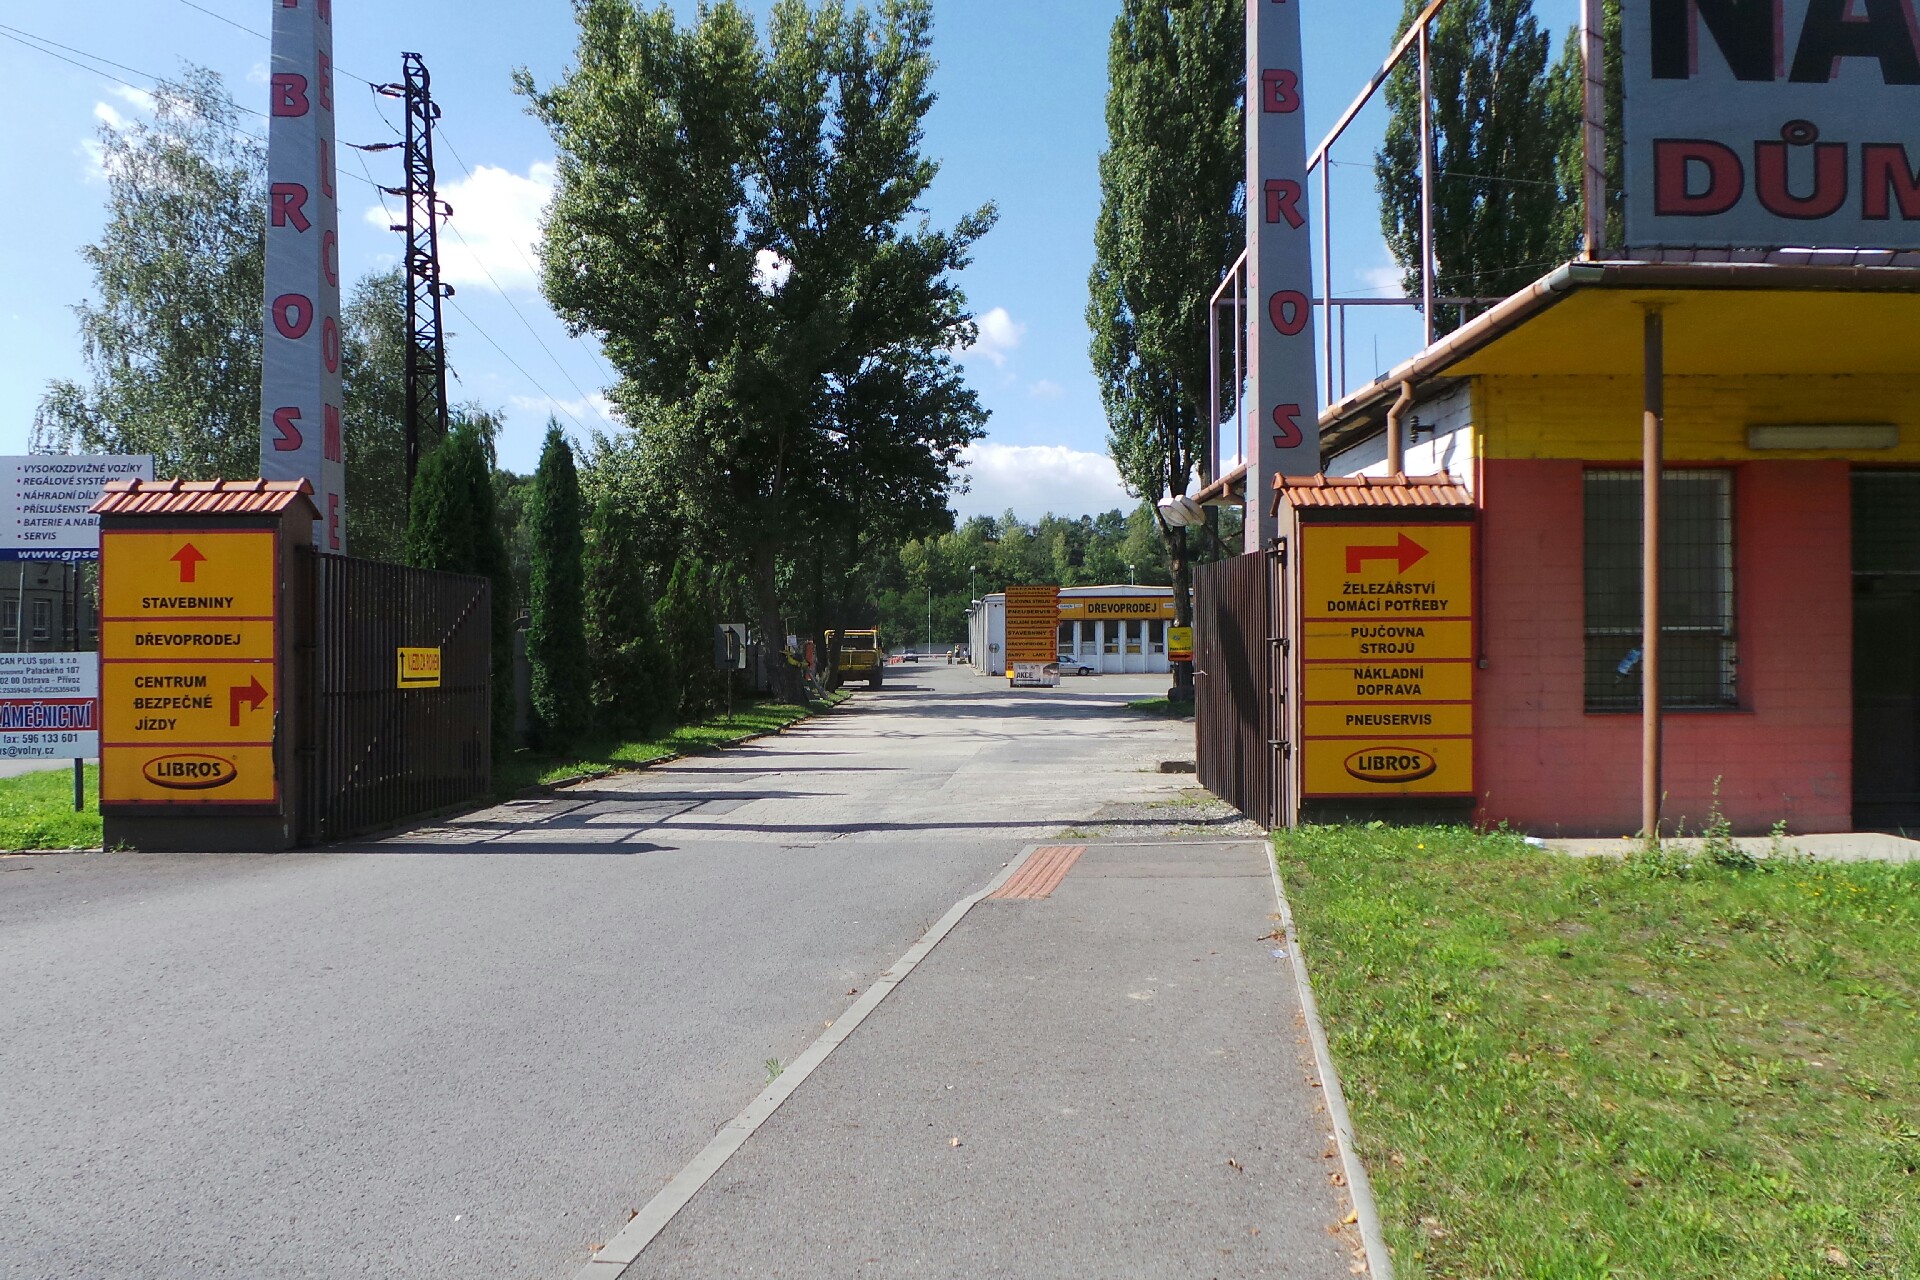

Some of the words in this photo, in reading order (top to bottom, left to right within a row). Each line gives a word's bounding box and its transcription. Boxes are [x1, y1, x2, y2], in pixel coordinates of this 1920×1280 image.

[270, 0, 312, 452] BROS
[1261, 0, 1310, 449] BROS
[24, 464, 105, 473] VYSOKOZDVIŽNÉ
[107, 463, 142, 473] VOZÍKY
[23, 475, 73, 486] REGÁLOVÉ
[23, 490, 77, 500] NÁHRADNÍ
[78, 490, 99, 500] DÍLY
[23, 518, 63, 526] BATERIE
[64, 518, 72, 526] A
[23, 532, 57, 541] SERVIS
[1343, 581, 1435, 594] ŽELEZÁŘSTVÍ
[142, 597, 233, 608] STAVEBNINY
[1088, 602, 1157, 613] DŘEVOPRODEJ
[1327, 600, 1380, 611] DOMÁCÍ
[1385, 599, 1449, 611] POTŘEBY
[1351, 625, 1425, 637] PŮJČOVNA
[135, 632, 241, 645] DŘEVOPRODEJ
[1360, 640, 1415, 654] STROJŮ
[1354, 666, 1424, 679] NÁKLADNÍ
[134, 676, 207, 688] CENTRUM
[1357, 684, 1421, 695] DOPRAVA
[134, 695, 213, 709] BEZPEČNÉ
[0, 701, 93, 728] ÁMEČNICTVÍ
[1346, 714, 1432, 725] PNEUSERVIS
[134, 717, 177, 730] JÍZDY
[4, 735, 19, 743] fax:
[22, 734, 38, 743] 596
[42, 734, 58, 742] 133
[61, 733, 78, 742] 601
[1358, 755, 1421, 771] LIBROS
[157, 763, 221, 778] LIBROS
